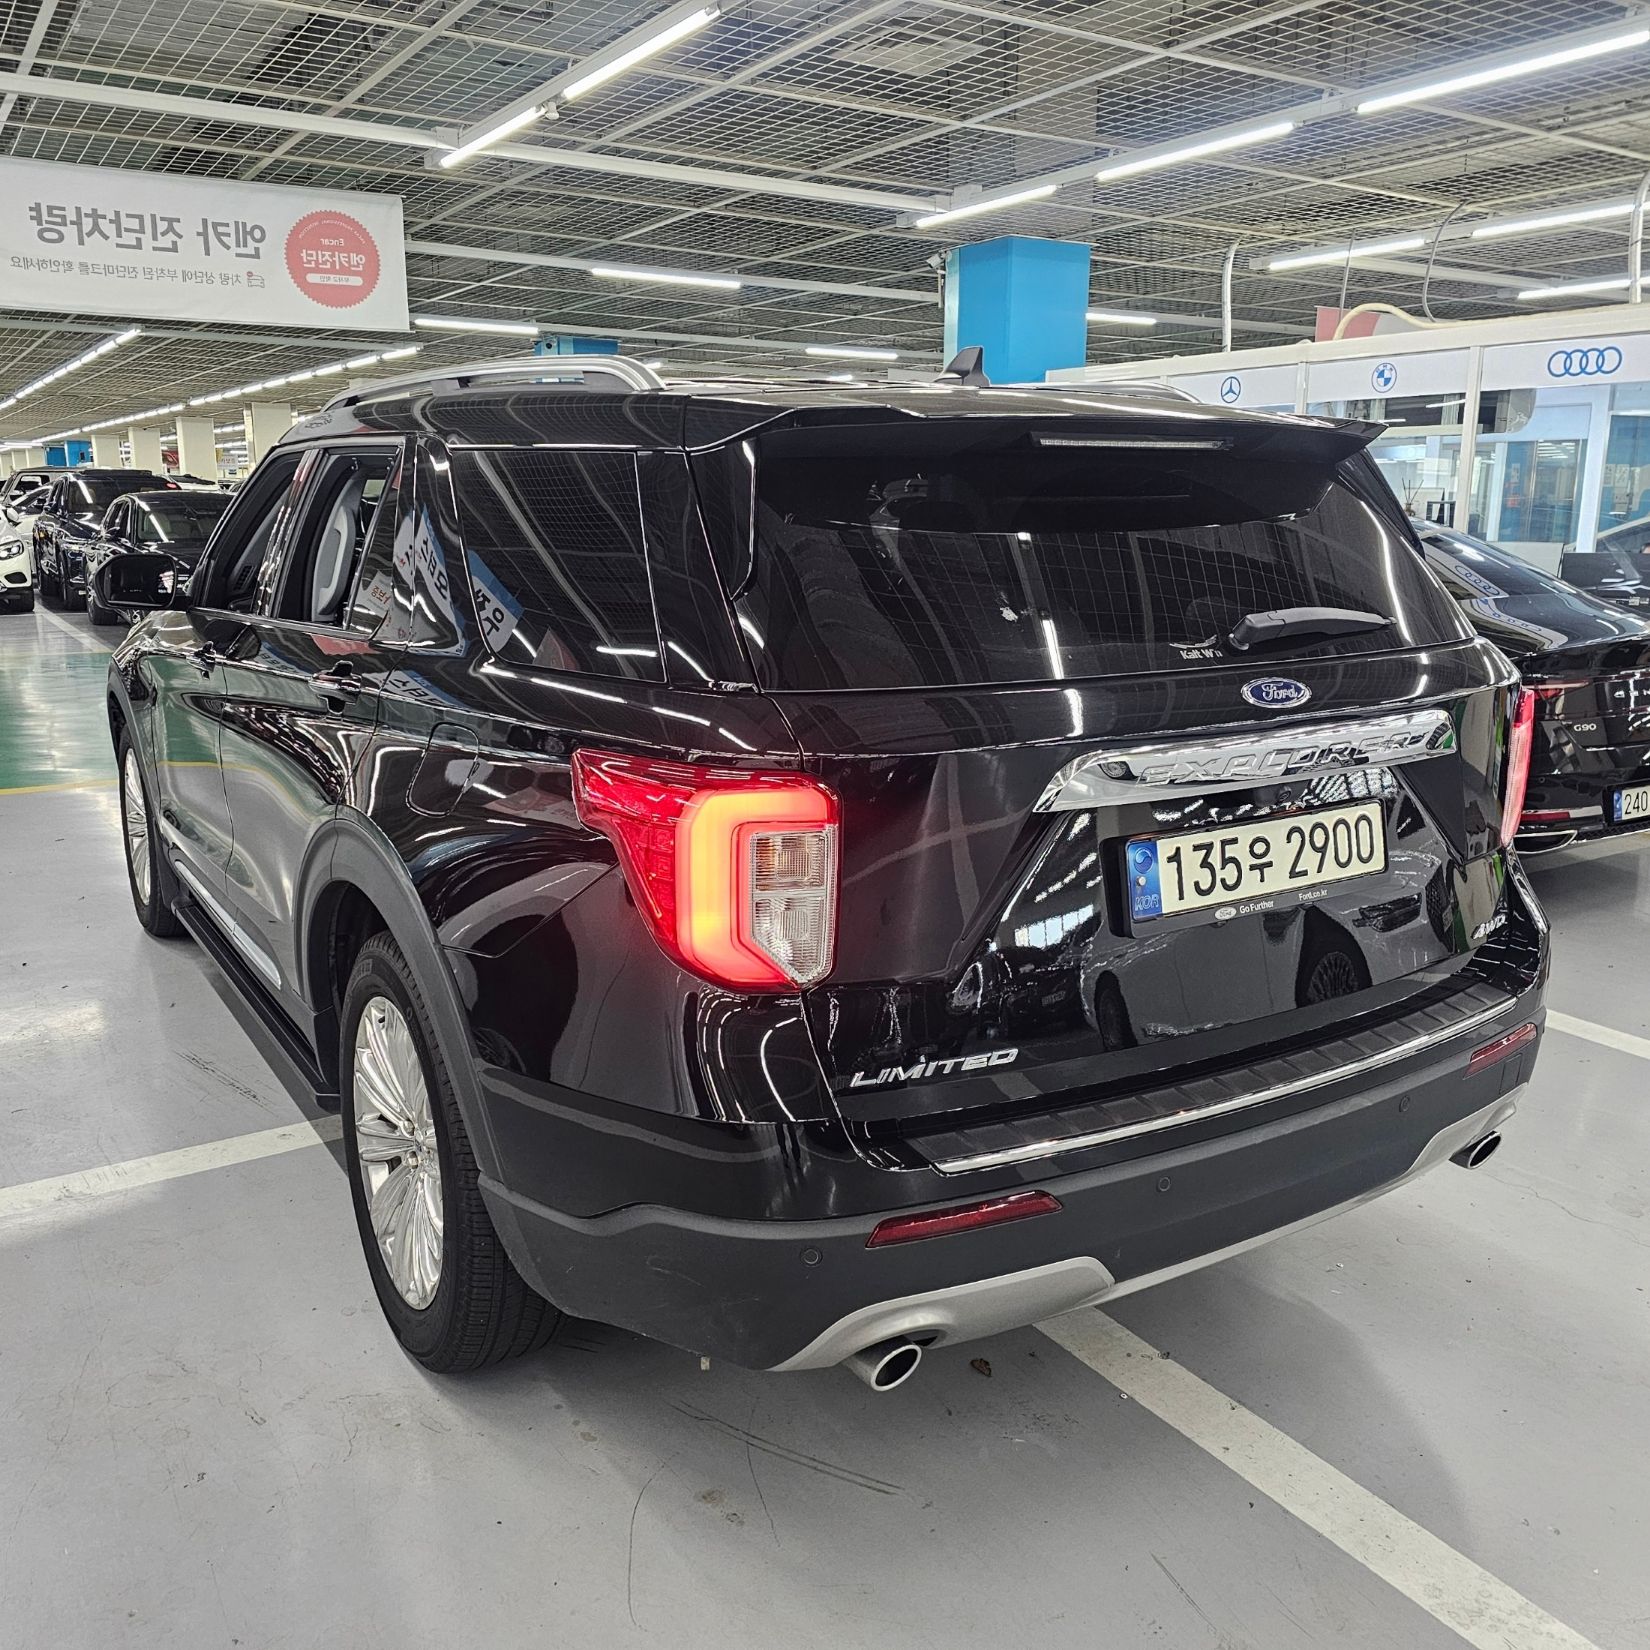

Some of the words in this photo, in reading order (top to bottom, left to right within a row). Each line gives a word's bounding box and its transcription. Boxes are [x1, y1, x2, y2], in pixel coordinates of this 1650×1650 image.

[1179, 649, 1202, 660] Kalt
[1573, 723, 1597, 732] G90
[1136, 730, 1420, 786] EXPLORER
[1166, 835, 1274, 901] 135우
[1286, 813, 1375, 880] 2900
[1135, 893, 1160, 912] KOR
[1239, 905, 1250, 914] Go
[1249, 900, 1274, 911] Further
[850, 1048, 1019, 1088] LIMITED
